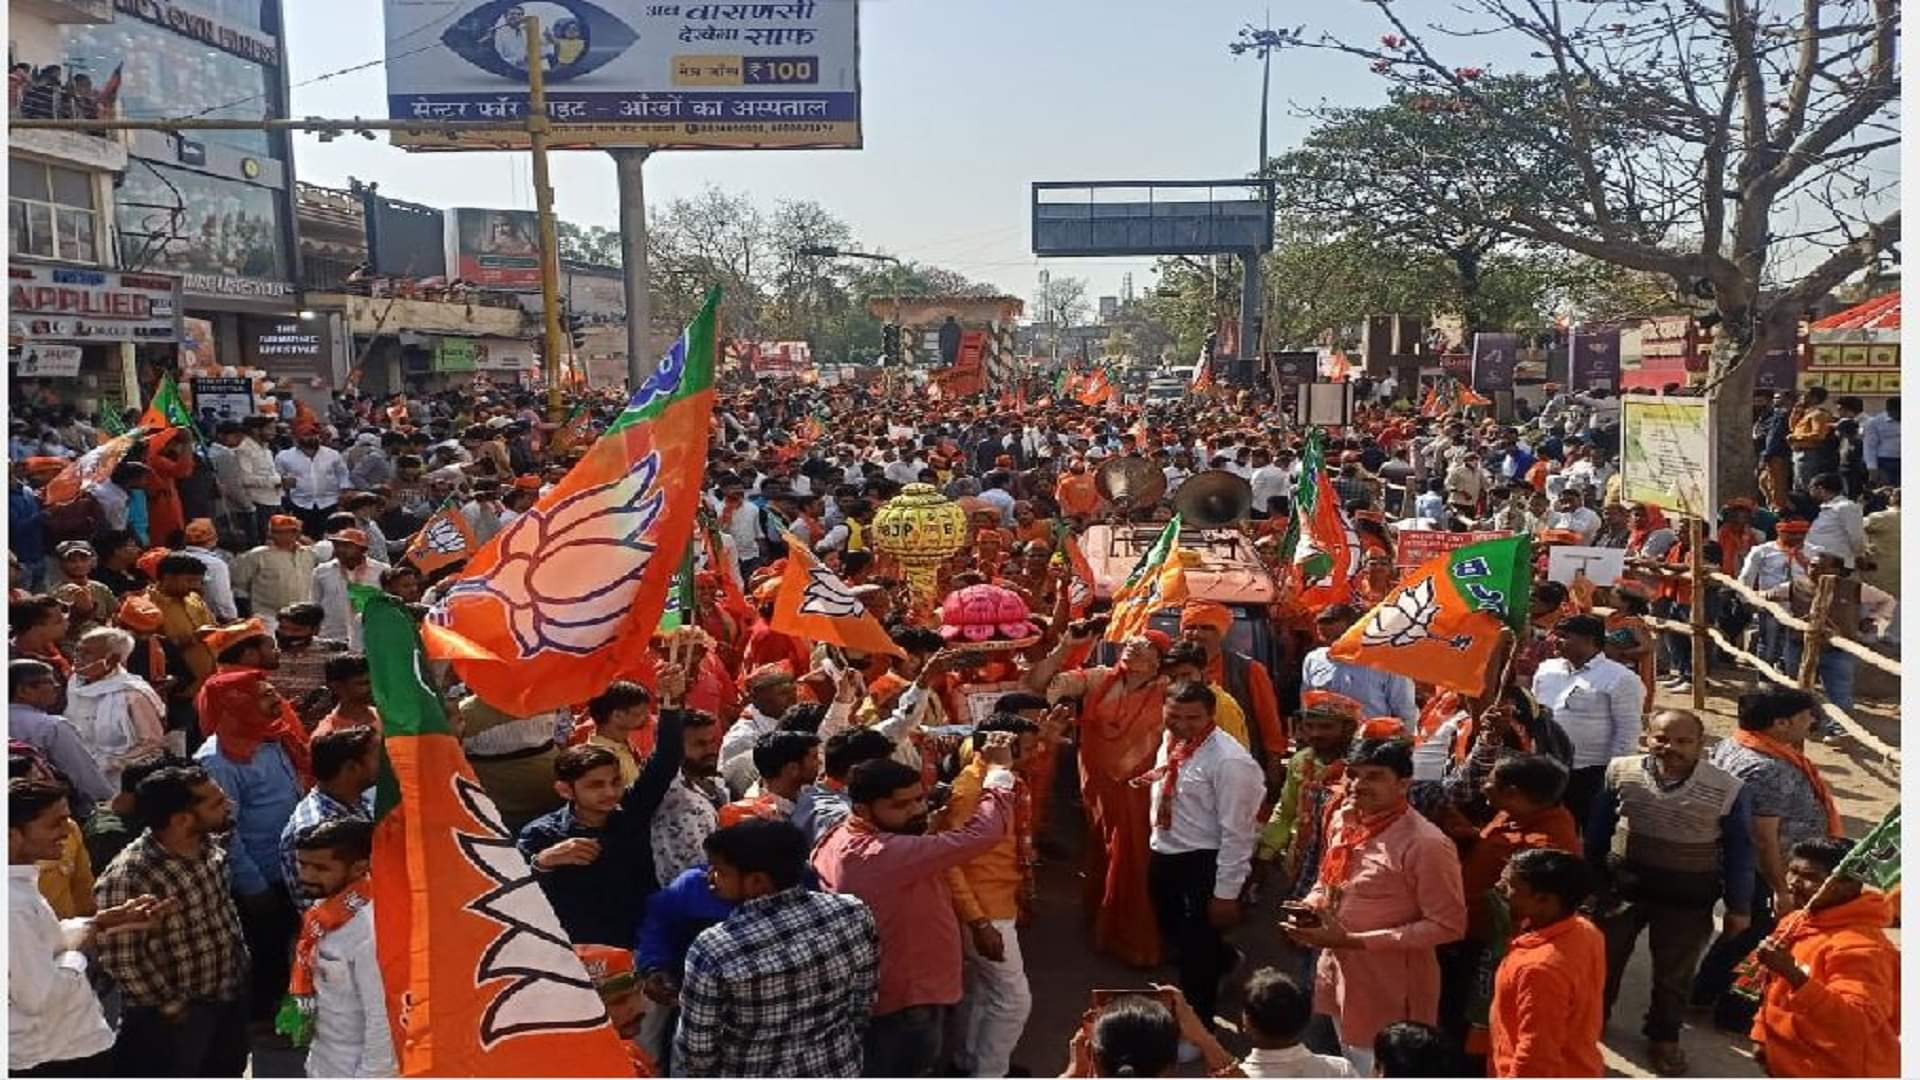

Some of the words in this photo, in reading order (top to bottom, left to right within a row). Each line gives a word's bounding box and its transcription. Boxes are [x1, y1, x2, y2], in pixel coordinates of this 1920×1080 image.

[685, 0, 816, 21] वाराणसी
[744, 28, 819, 46] साफ
[476, 96, 521, 117] फॉर
[620, 94, 683, 117] आँखों
[690, 101, 723, 116] का
[731, 100, 829, 117] अस्पताल
[13, 284, 151, 319] APPLIED
